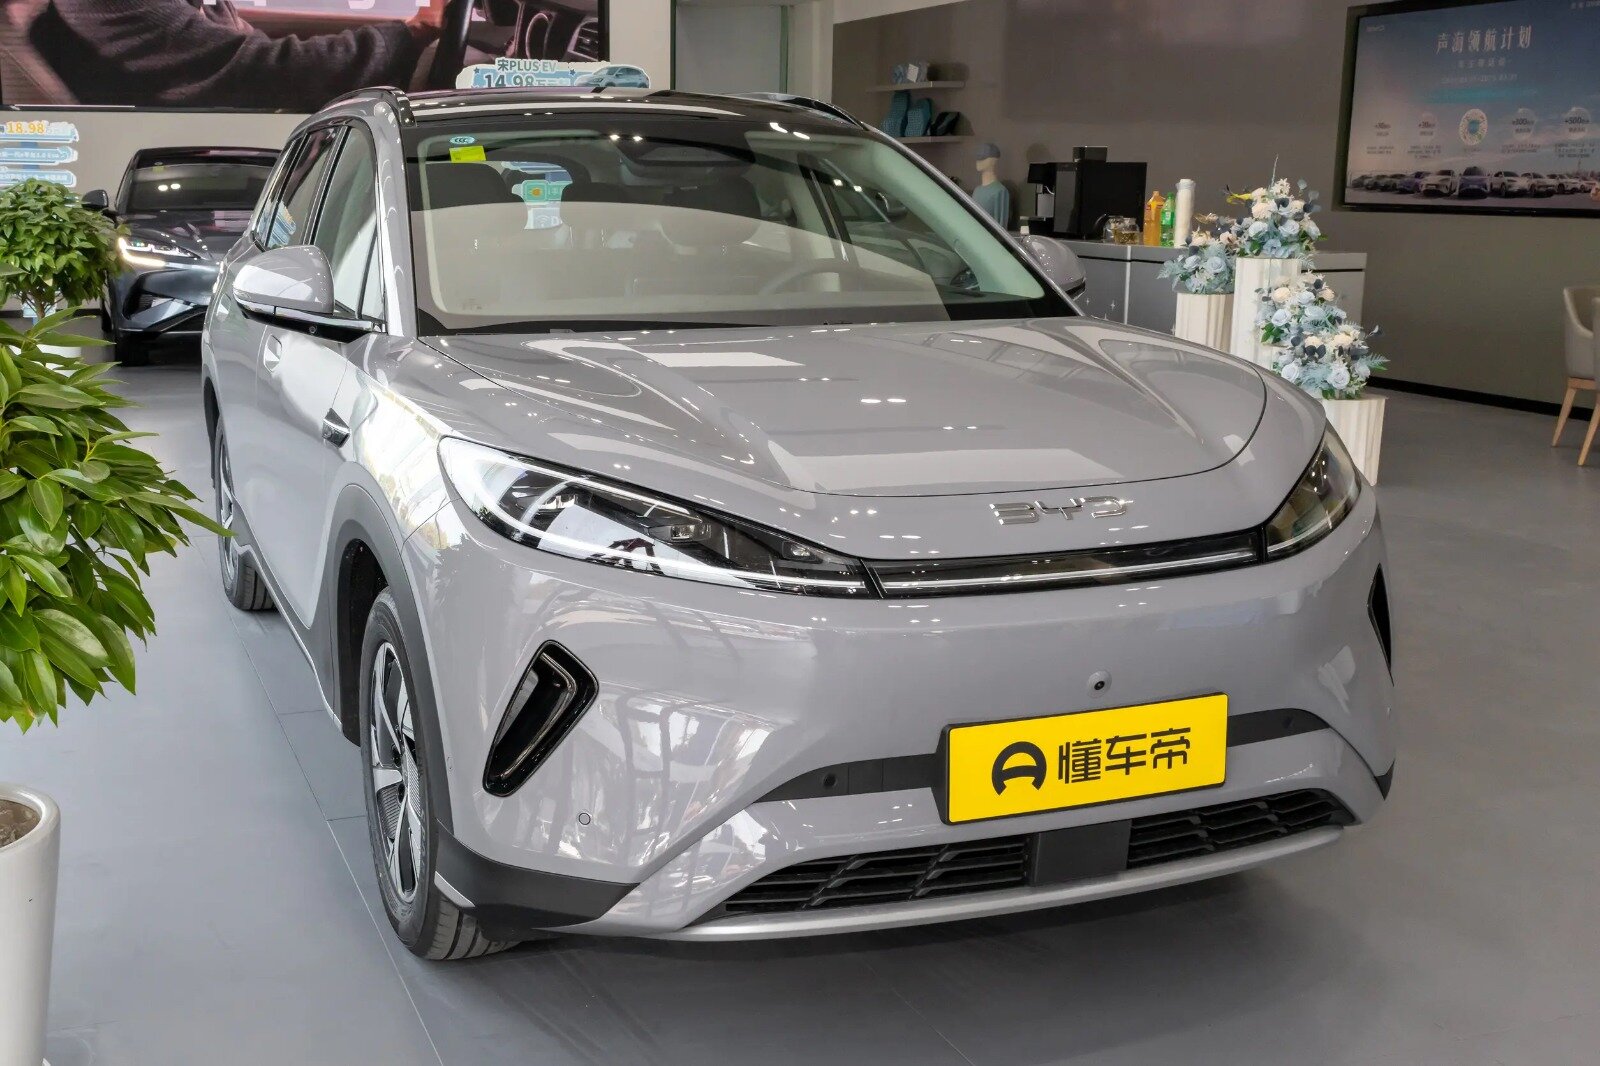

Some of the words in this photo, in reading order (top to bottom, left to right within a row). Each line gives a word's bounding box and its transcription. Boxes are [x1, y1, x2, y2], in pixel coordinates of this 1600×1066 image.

[497, 58, 539, 72] 宋PLUS
[542, 60, 557, 72] EV
[989, 495, 1127, 525] BYD
[1058, 727, 1191, 784] 懂车帝
